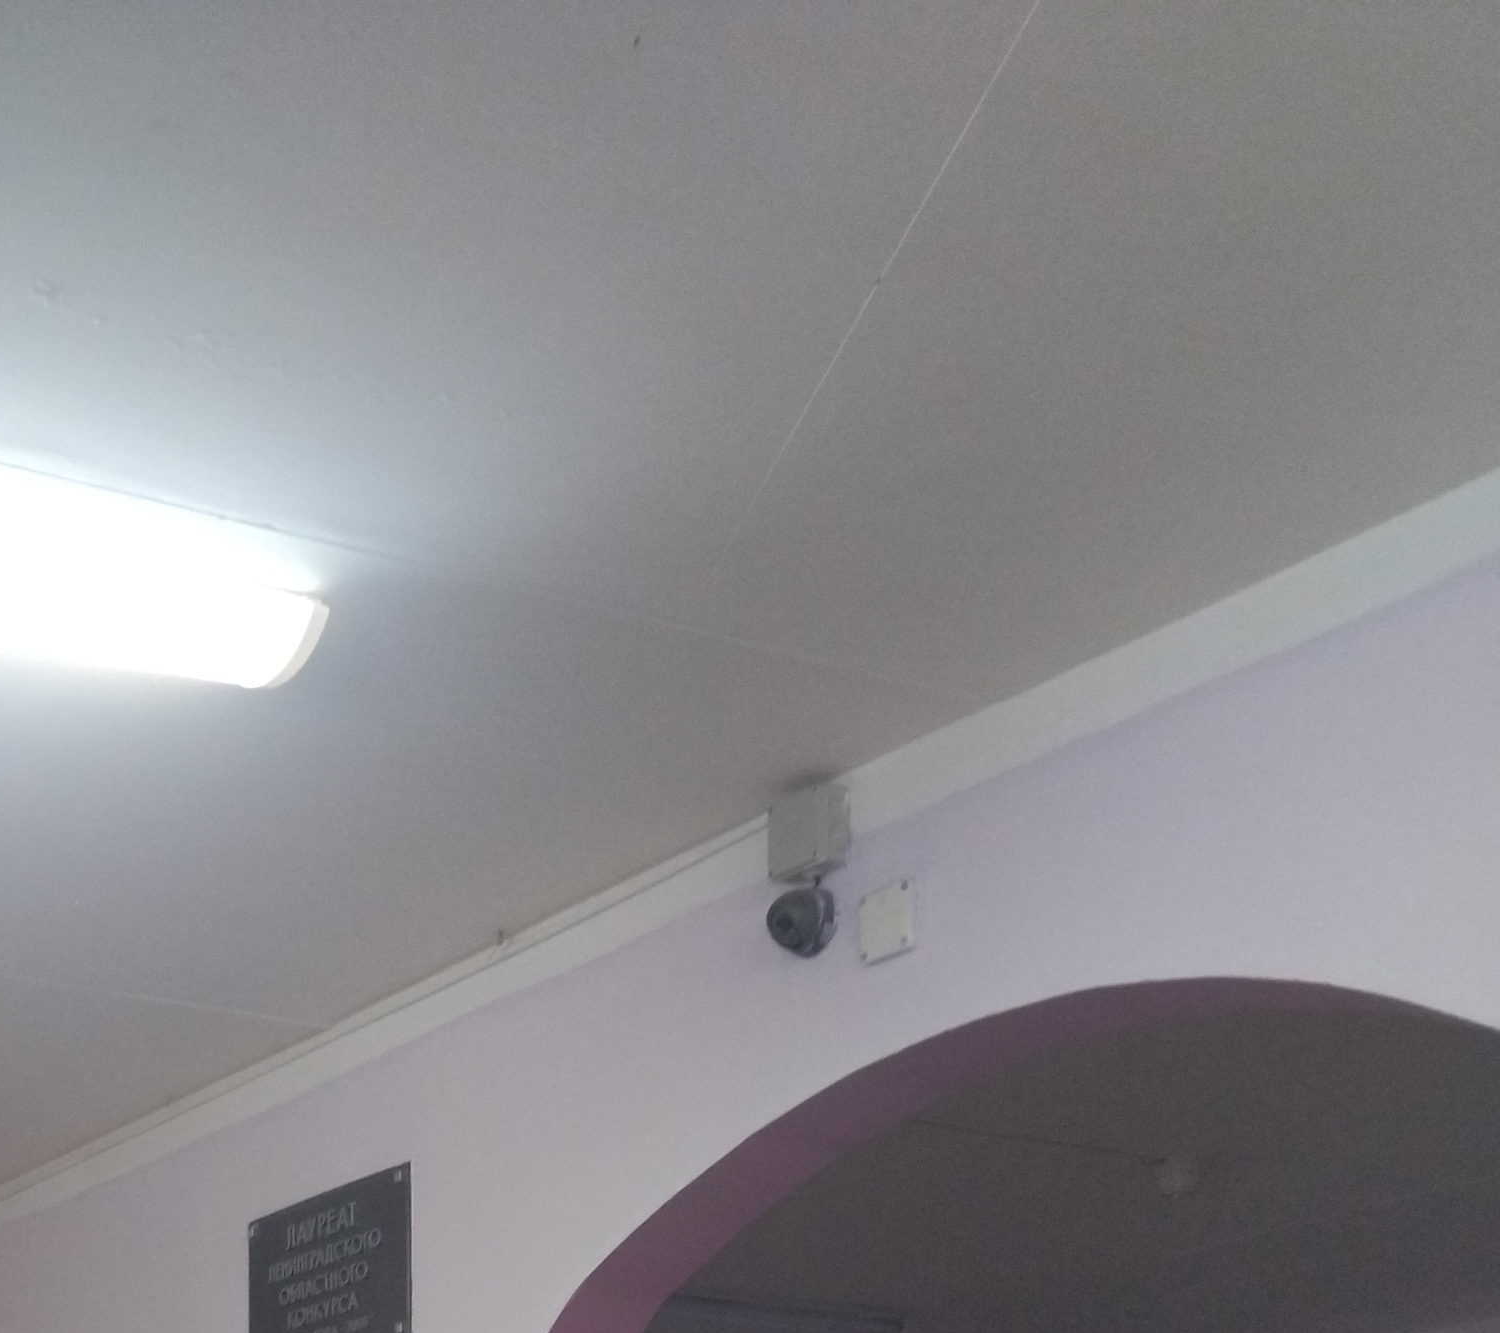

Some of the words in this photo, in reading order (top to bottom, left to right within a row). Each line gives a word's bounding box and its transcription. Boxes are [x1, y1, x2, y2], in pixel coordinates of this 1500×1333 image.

[286, 1202, 358, 1250] ЛАУРЕАТ
[268, 1228, 381, 1284] ЛЕНИНГРАДСКОГО
[279, 1262, 368, 1306] ОБЛАСТНОГО
[287, 1292, 359, 1330] КОНКУРСА
